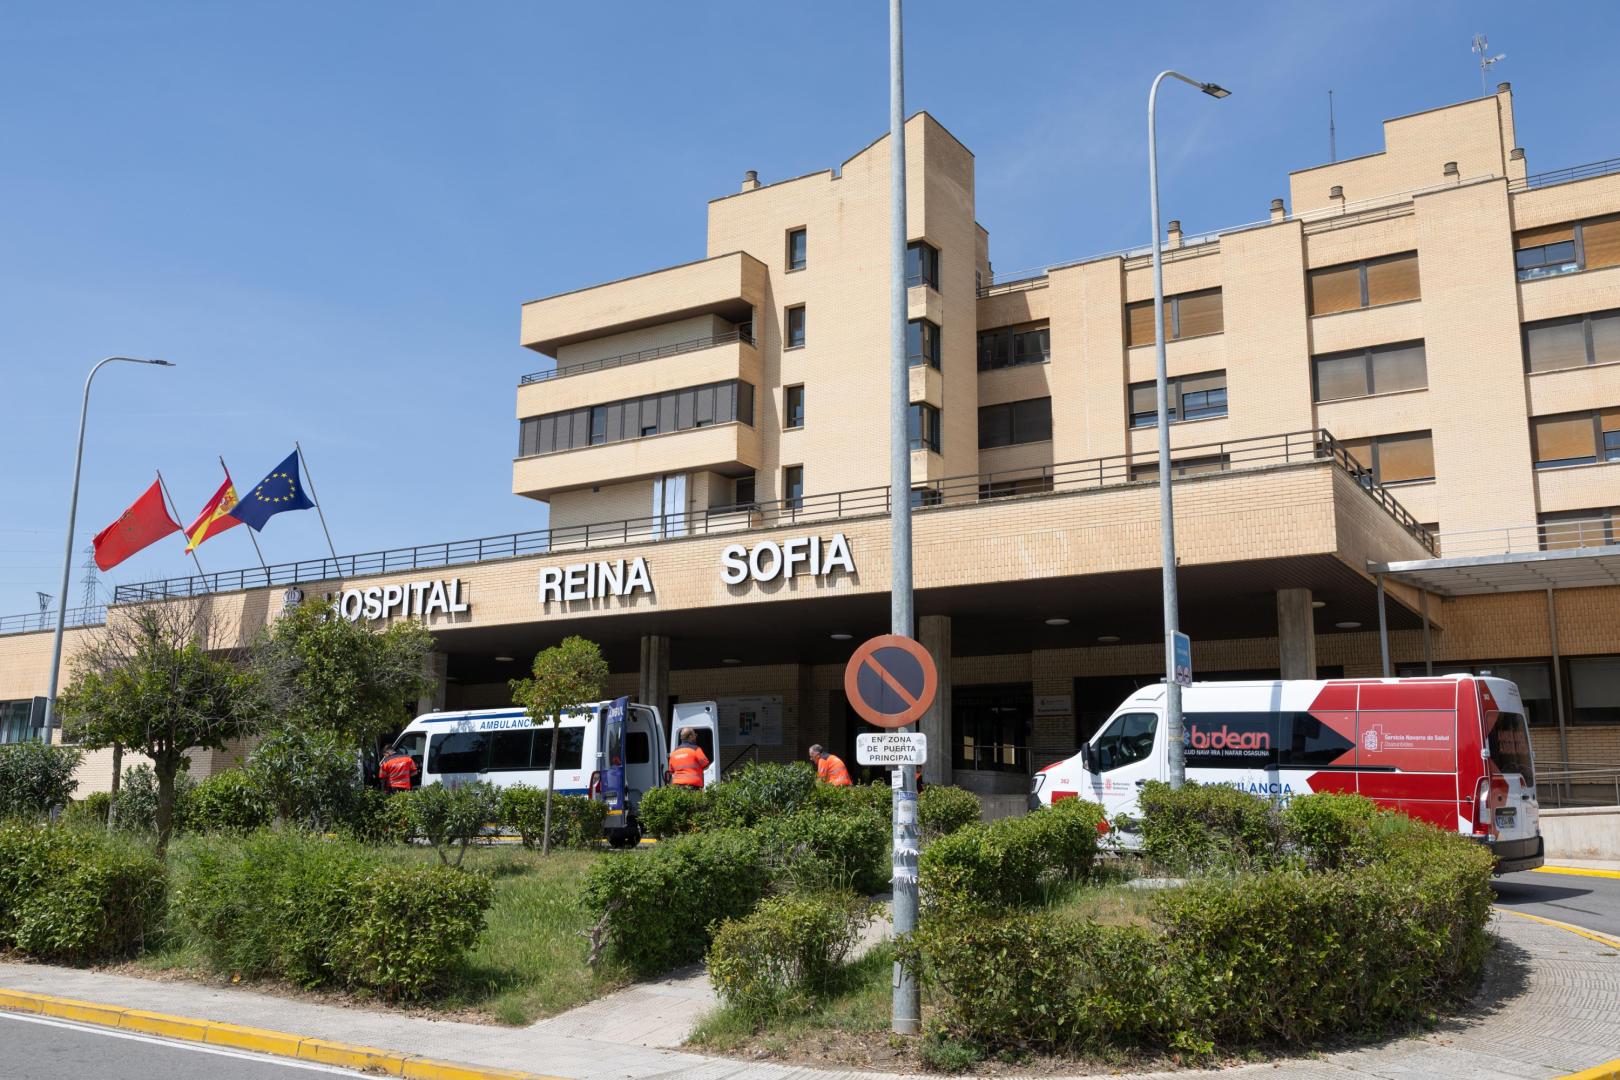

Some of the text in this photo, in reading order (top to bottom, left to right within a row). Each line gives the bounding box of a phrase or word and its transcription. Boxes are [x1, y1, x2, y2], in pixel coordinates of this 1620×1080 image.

[539, 555, 652, 603] REINA
[720, 532, 855, 585] SOFIA
[480, 718, 540, 730] AMBULANCI
[1191, 724, 1270, 750] bidean
[869, 754, 914, 762] PRINCIPAL
